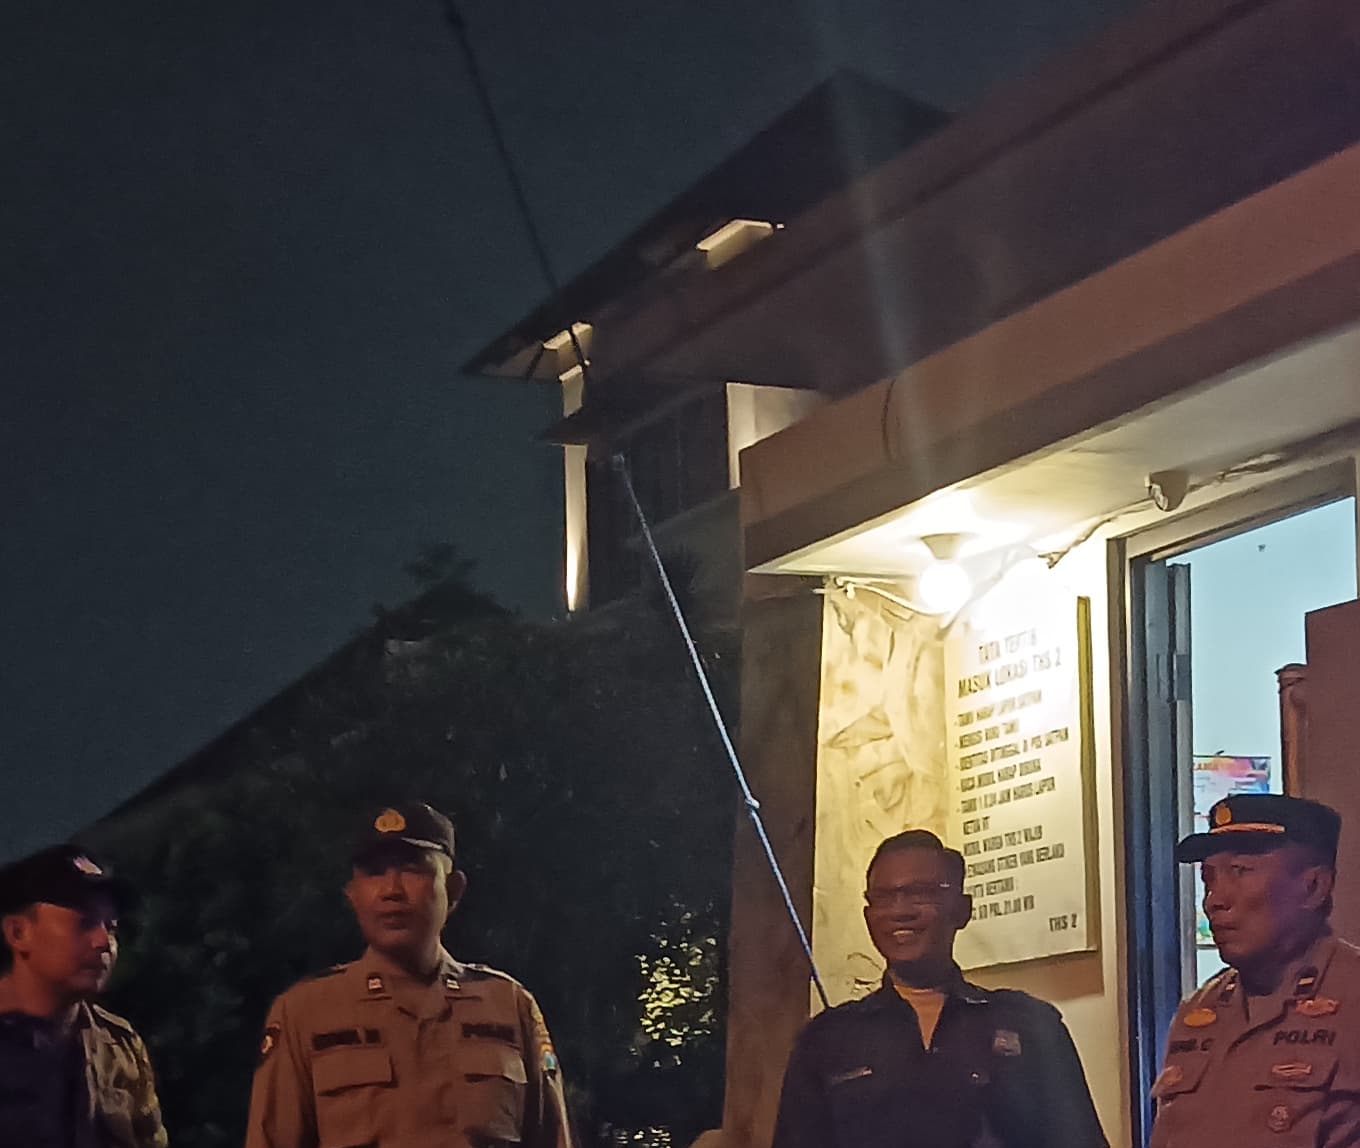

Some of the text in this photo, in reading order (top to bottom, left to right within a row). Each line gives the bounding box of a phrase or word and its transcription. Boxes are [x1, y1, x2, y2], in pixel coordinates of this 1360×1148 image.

[958, 670, 991, 698] MASUK
[1049, 913, 1078, 932] THS 2
[1272, 1028, 1337, 1047] POLRI
